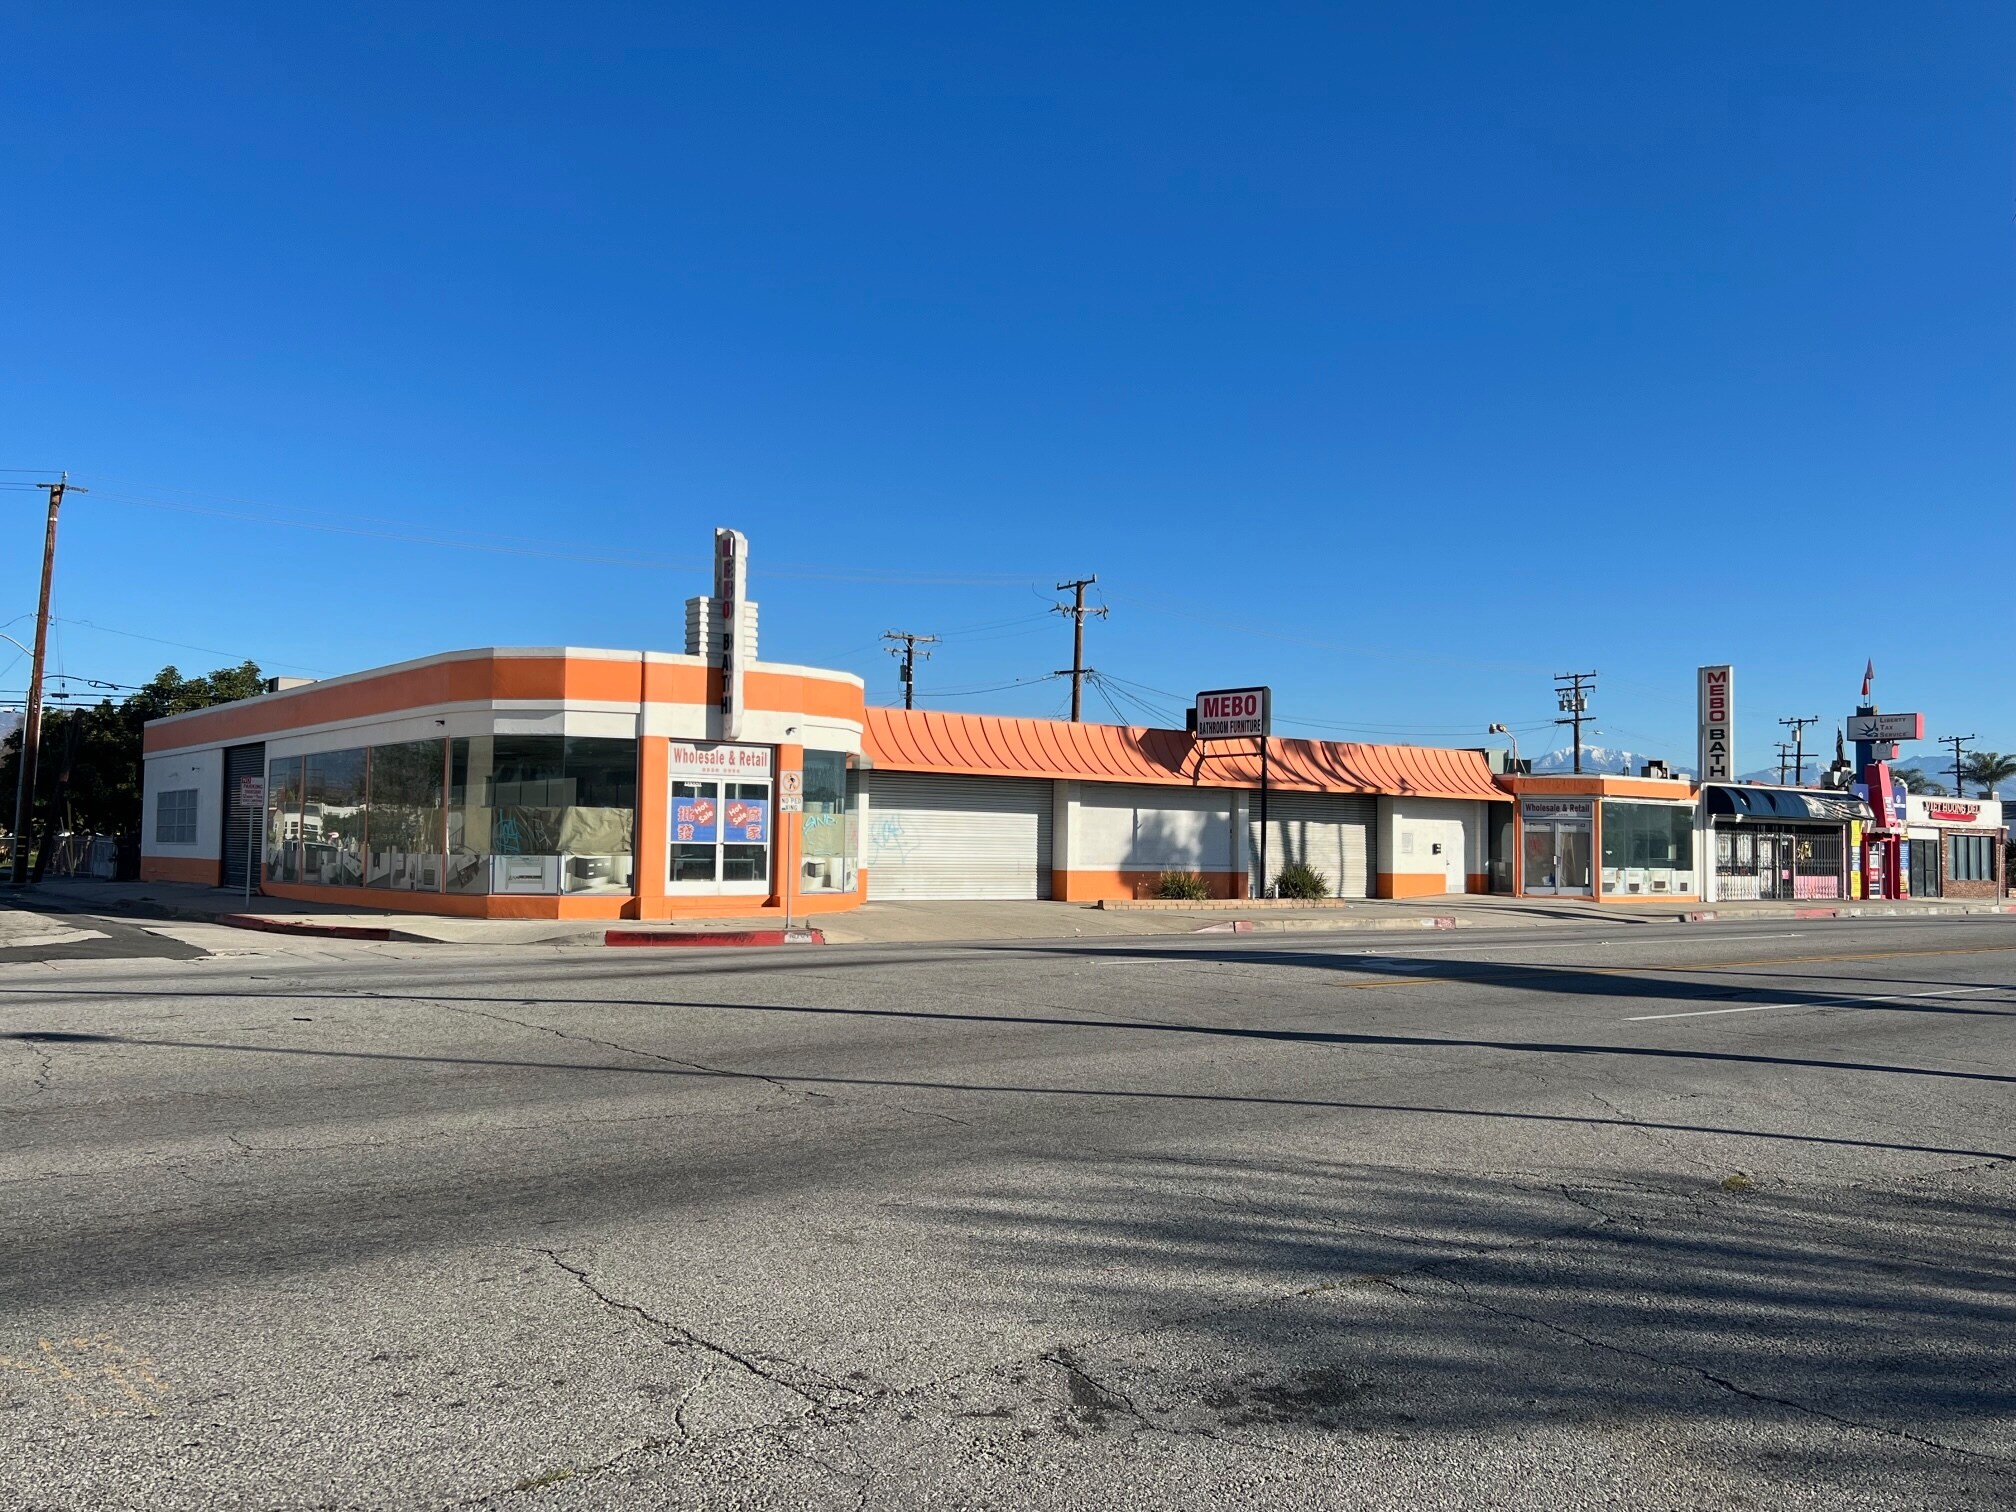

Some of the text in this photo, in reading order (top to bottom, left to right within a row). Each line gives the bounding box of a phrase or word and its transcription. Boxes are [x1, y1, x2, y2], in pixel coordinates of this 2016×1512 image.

[1707, 671, 1726, 722] MEBO
[1204, 695, 1257, 718] MEBO
[1199, 719, 1261, 735] BATHROOM FURNITURE
[674, 747, 767, 767] Wholesale & Retail
[1709, 729, 1725, 776] BATH
[694, 802, 708, 815] Hot
[728, 803, 743, 817] Hot
[1525, 803, 1590, 813] Wholesale & Retail
[698, 810, 714, 824] Sale
[732, 811, 747, 825] Sale
